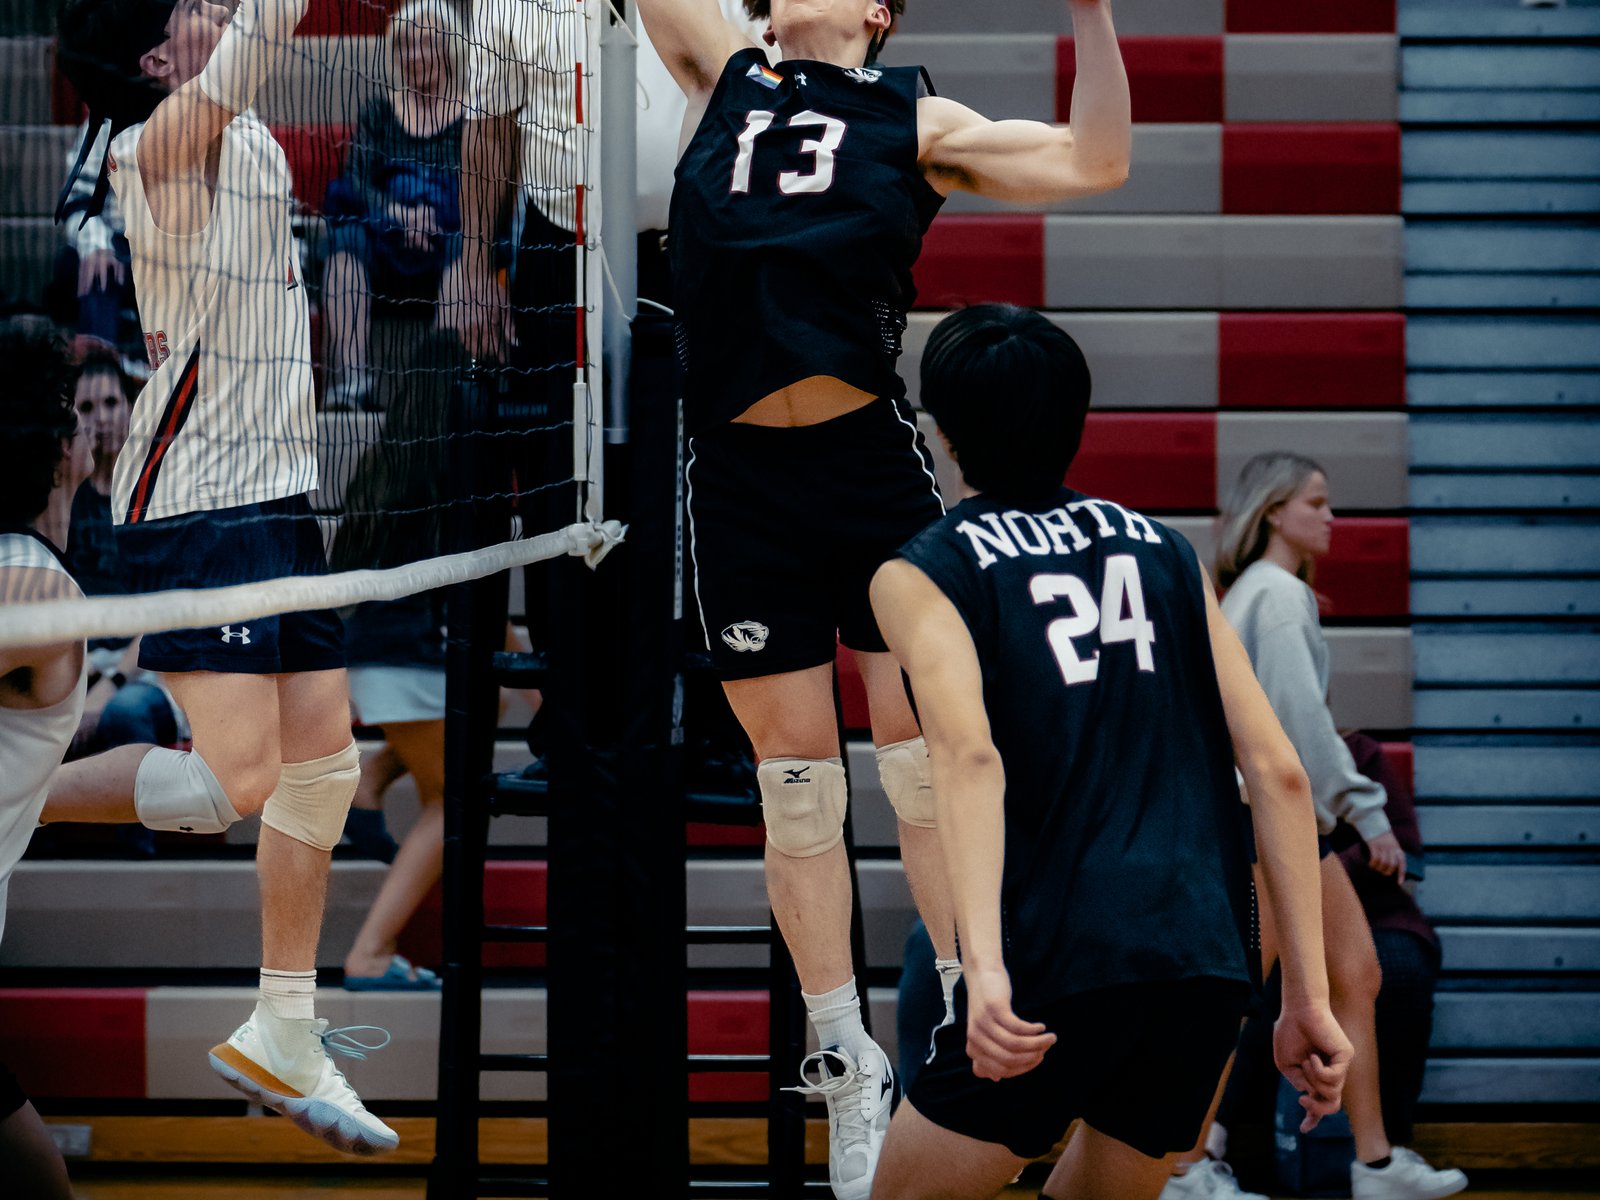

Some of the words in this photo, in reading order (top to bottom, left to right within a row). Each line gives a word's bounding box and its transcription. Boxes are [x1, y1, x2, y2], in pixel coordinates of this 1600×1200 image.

[730, 108, 848, 195] 13
[956, 499, 1162, 570] NORTH
[1029, 553, 1156, 686] 24
